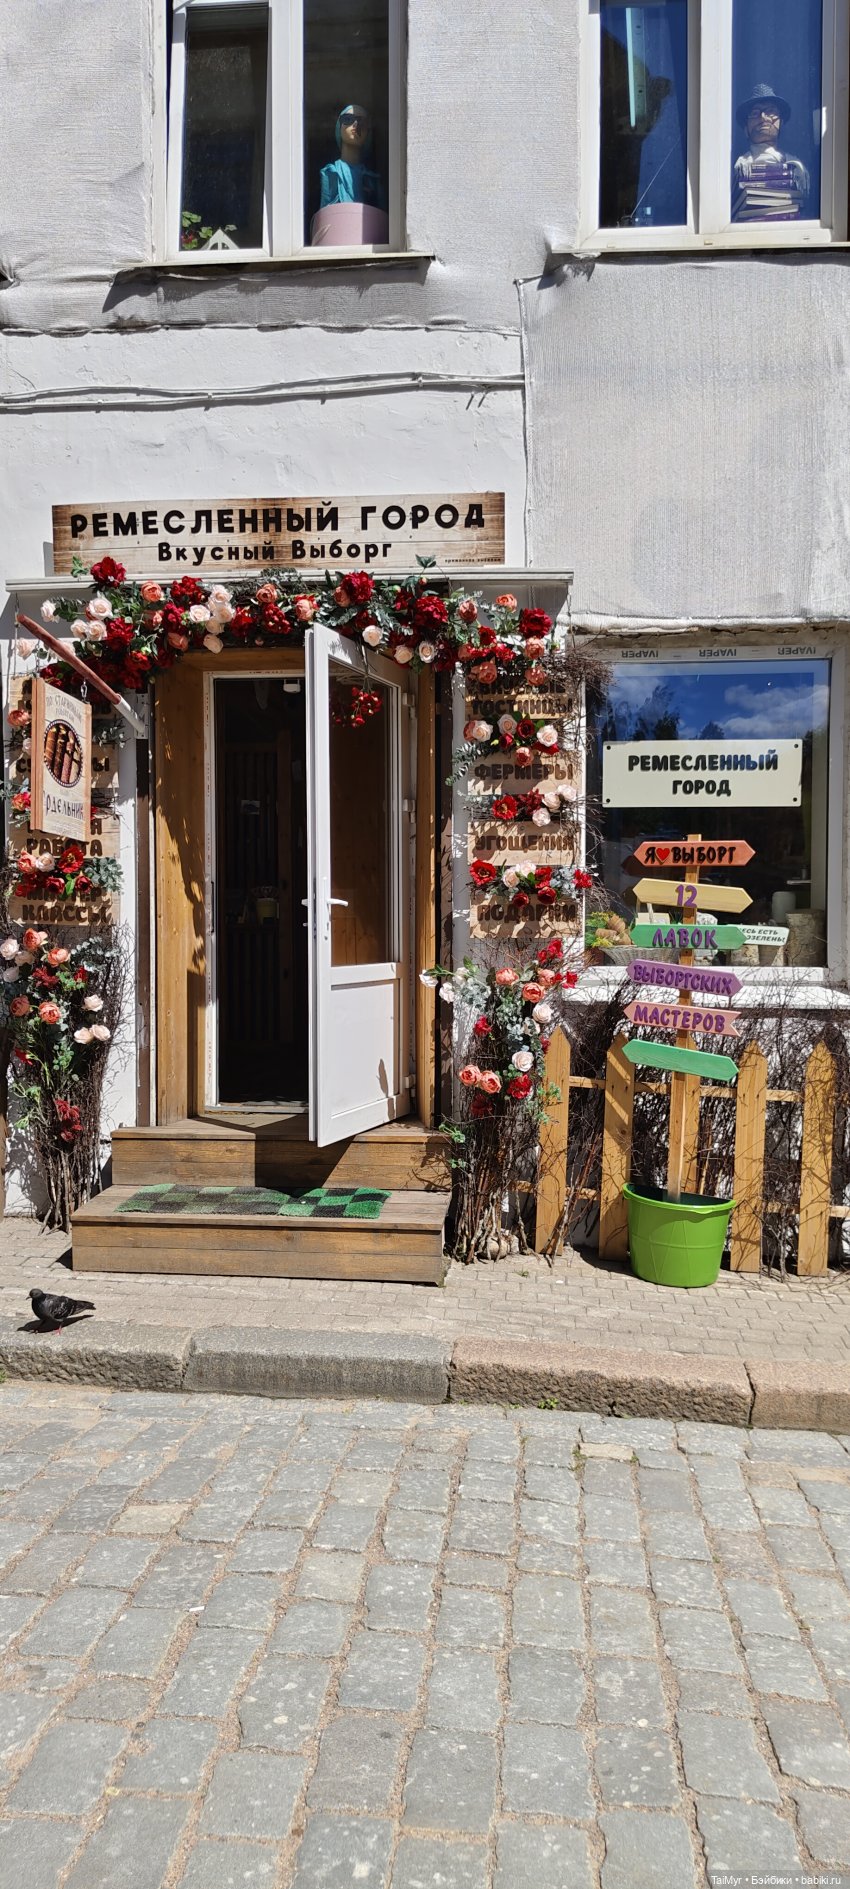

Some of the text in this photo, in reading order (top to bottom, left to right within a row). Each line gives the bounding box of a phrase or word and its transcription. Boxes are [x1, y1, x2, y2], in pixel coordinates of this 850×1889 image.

[70, 500, 486, 539] РЕМЕСЛЕННЫЙ ГОРОД
[158, 538, 393, 566] Вкусный Выборг
[474, 763, 574, 781] ФЕРМЕРЫ
[628, 749, 779, 773] РЕМЕСЛЕННЫЙ
[672, 779, 732, 797] ГОРОД
[474, 835, 575, 853] УГОЩЕНИЯ
[645, 845, 736, 864] Я ВЫБОРГ
[675, 884, 698, 908] 12
[477, 903, 576, 924] ПОДАРКИ
[652, 928, 718, 950] ЛАВОК
[633, 967, 732, 994] ВЫБОРГСКИХ
[633, 1005, 726, 1033] МАСТЕРОВ
